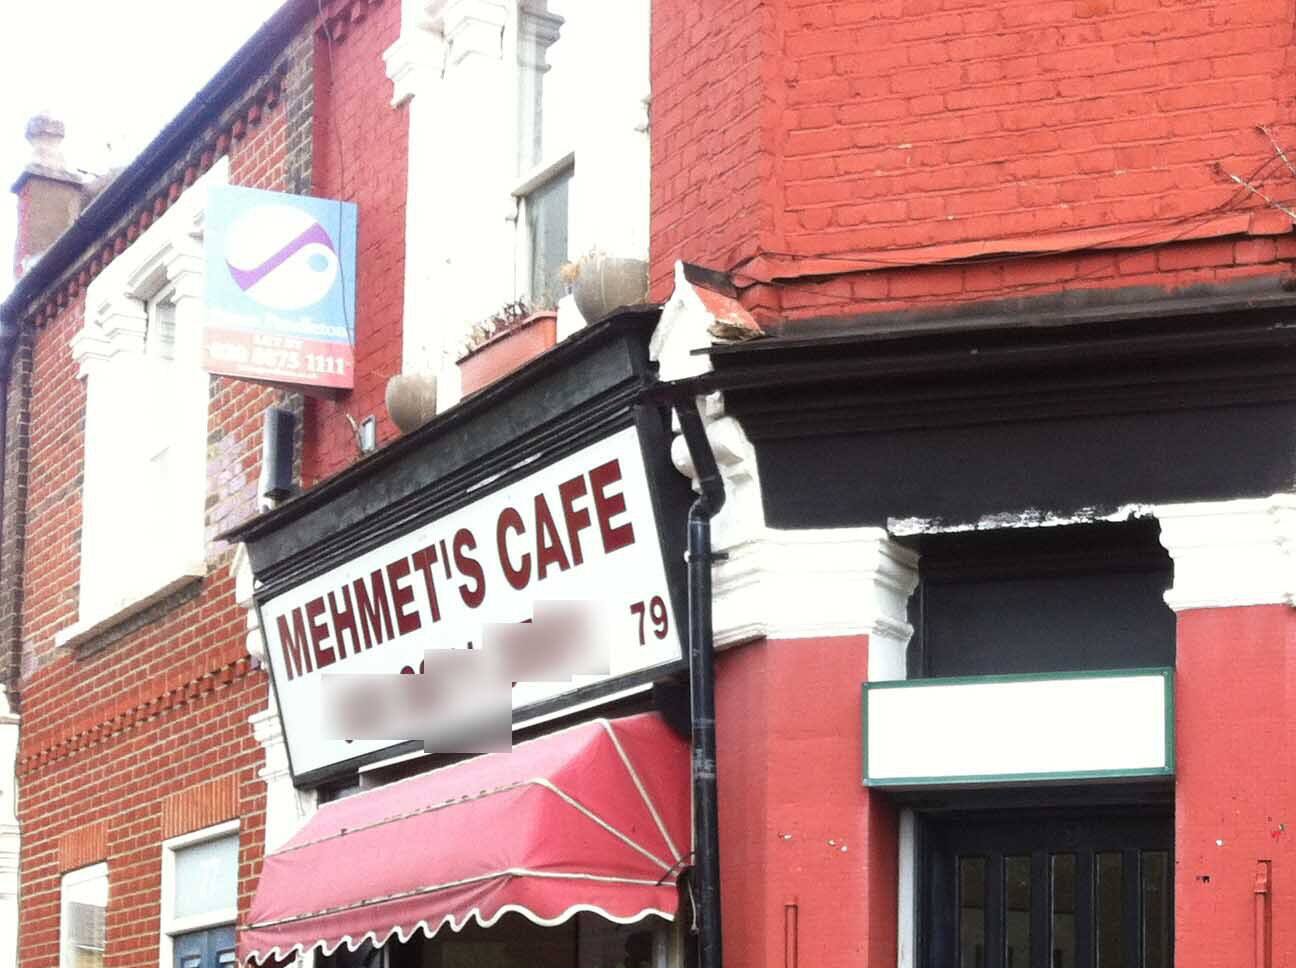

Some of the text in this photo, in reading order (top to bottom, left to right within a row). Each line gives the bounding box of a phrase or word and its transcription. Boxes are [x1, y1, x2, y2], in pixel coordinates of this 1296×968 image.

[276, 527, 486, 681] MEHMET'S
[496, 459, 635, 590] CAFE
[629, 595, 669, 646] 79
